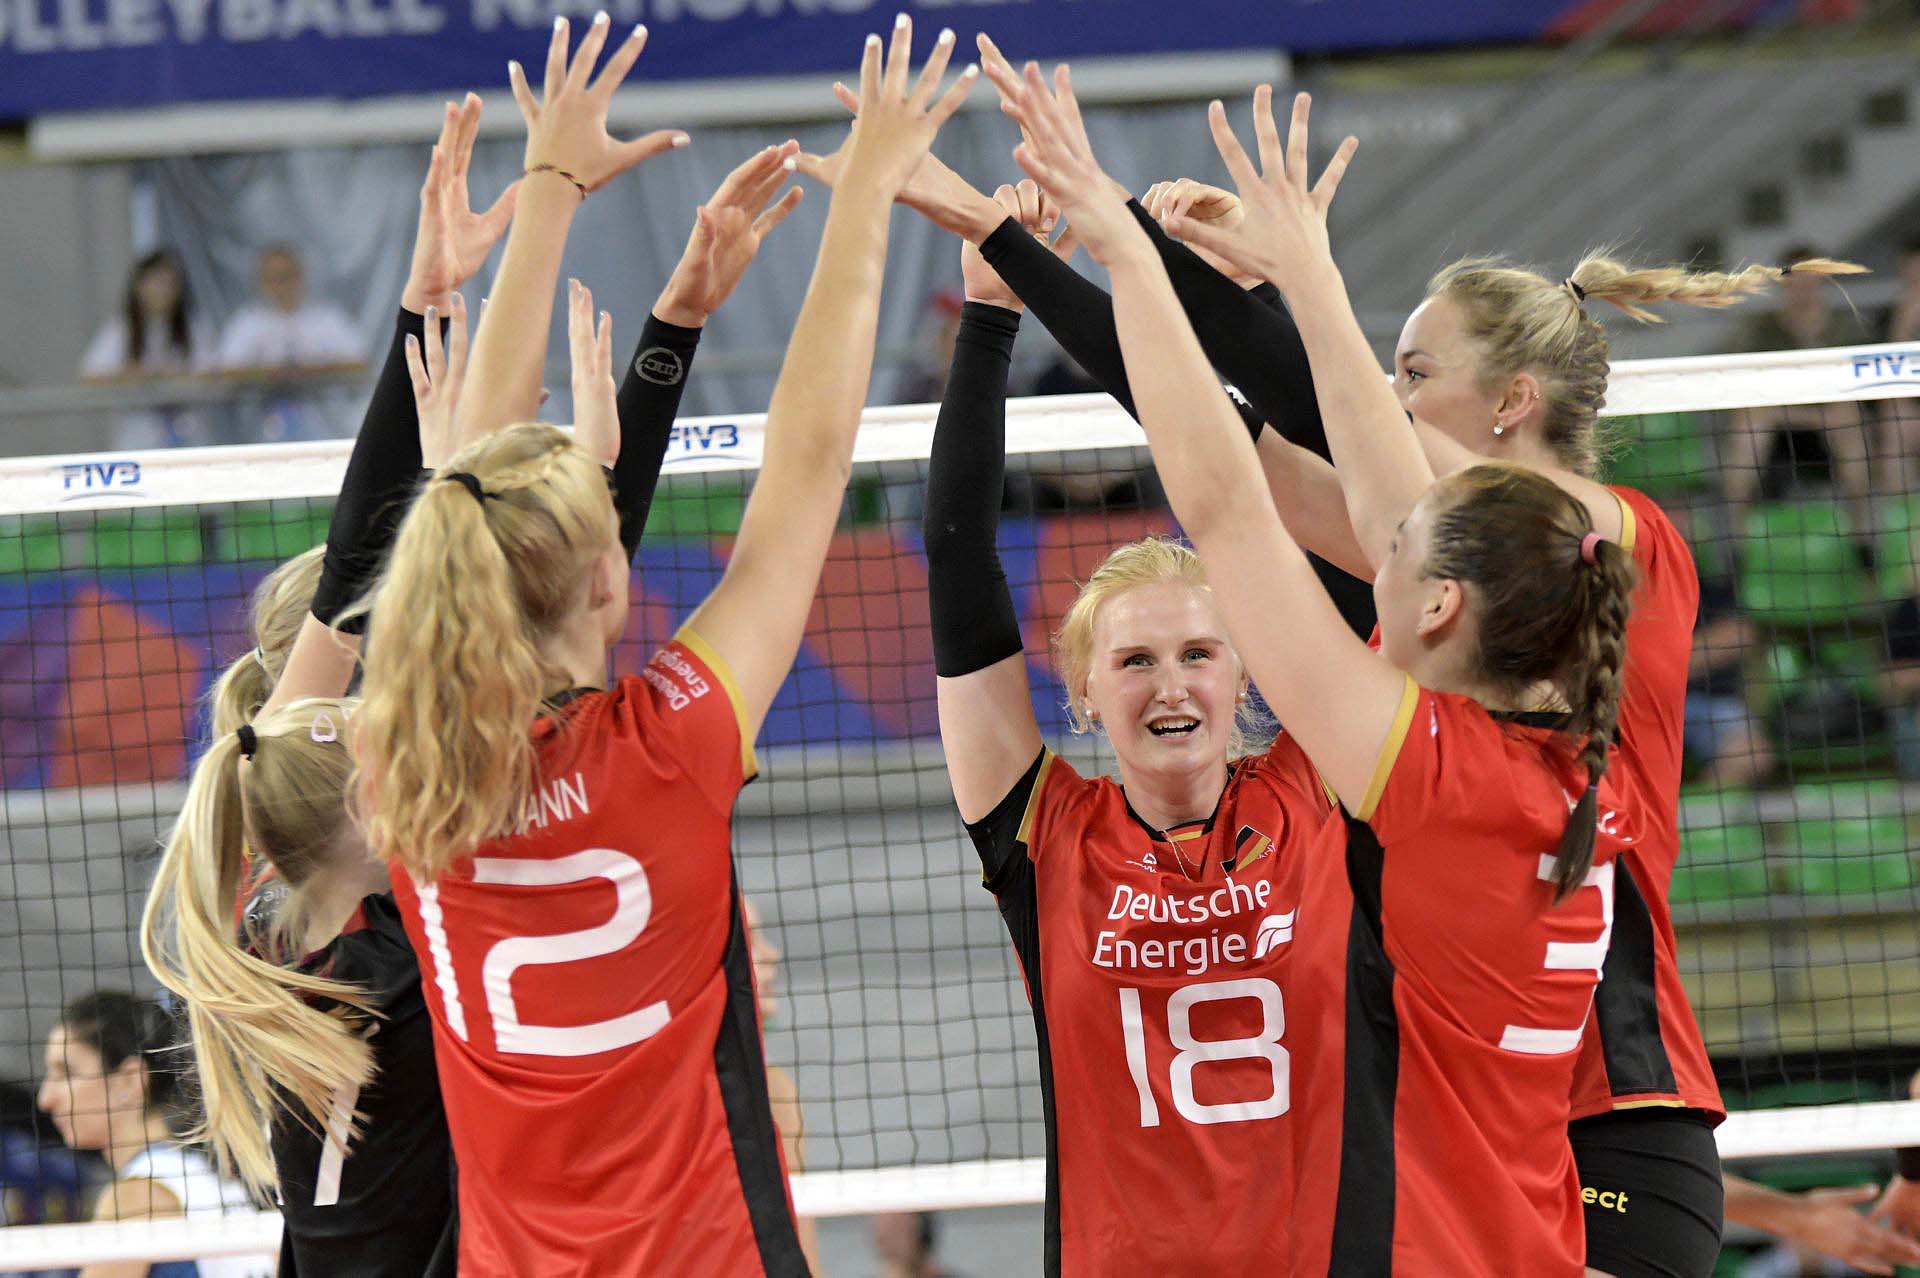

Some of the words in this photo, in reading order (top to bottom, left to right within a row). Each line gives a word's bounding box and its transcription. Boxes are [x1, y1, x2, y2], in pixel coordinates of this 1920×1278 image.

[62, 461, 142, 489] FIVB
[515, 771, 591, 836] ANN
[1107, 876, 1271, 924] Deutsche
[414, 848, 672, 1056] 12
[1092, 928, 1247, 975] Energie
[1118, 977, 1291, 1128] 18
[1581, 1187, 1629, 1213] ect
